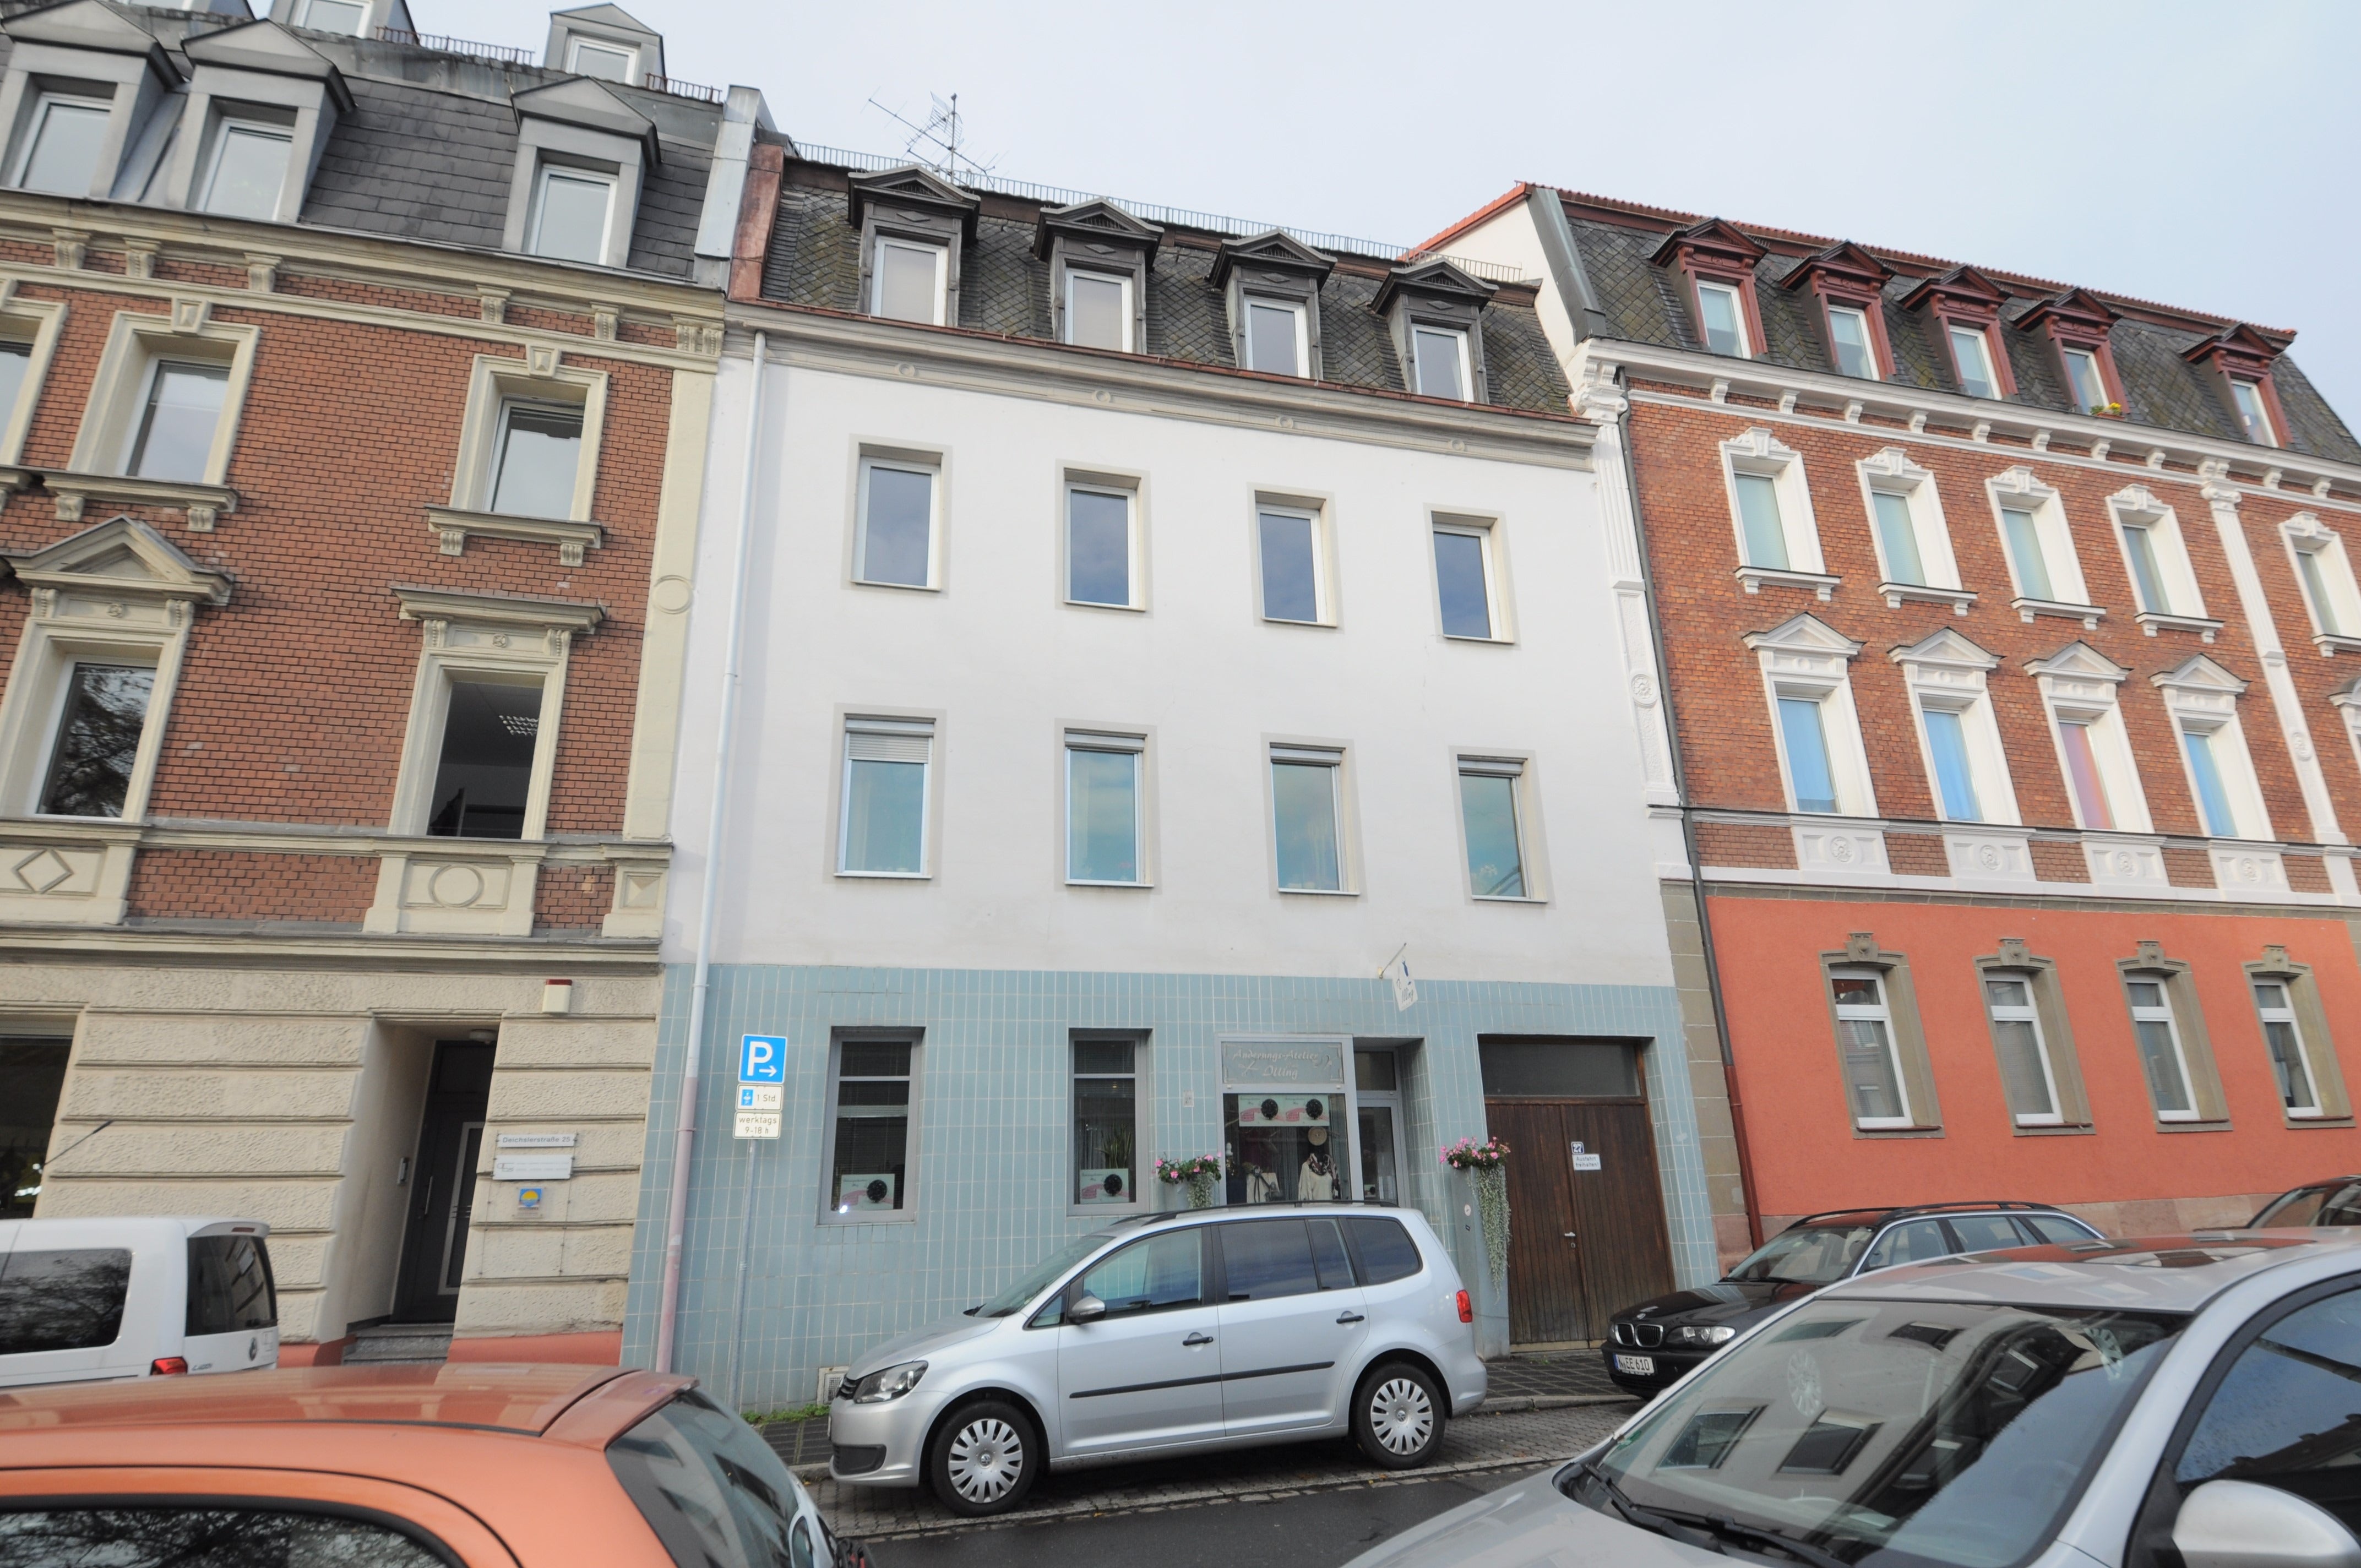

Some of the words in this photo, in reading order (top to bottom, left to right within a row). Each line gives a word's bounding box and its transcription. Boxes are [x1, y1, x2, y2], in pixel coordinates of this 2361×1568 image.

[747, 1041, 773, 1076] P
[739, 1117, 777, 1125] werktags
[1573, 1144, 1582, 1153] 27
[1635, 1358, 1650, 1370] 610
